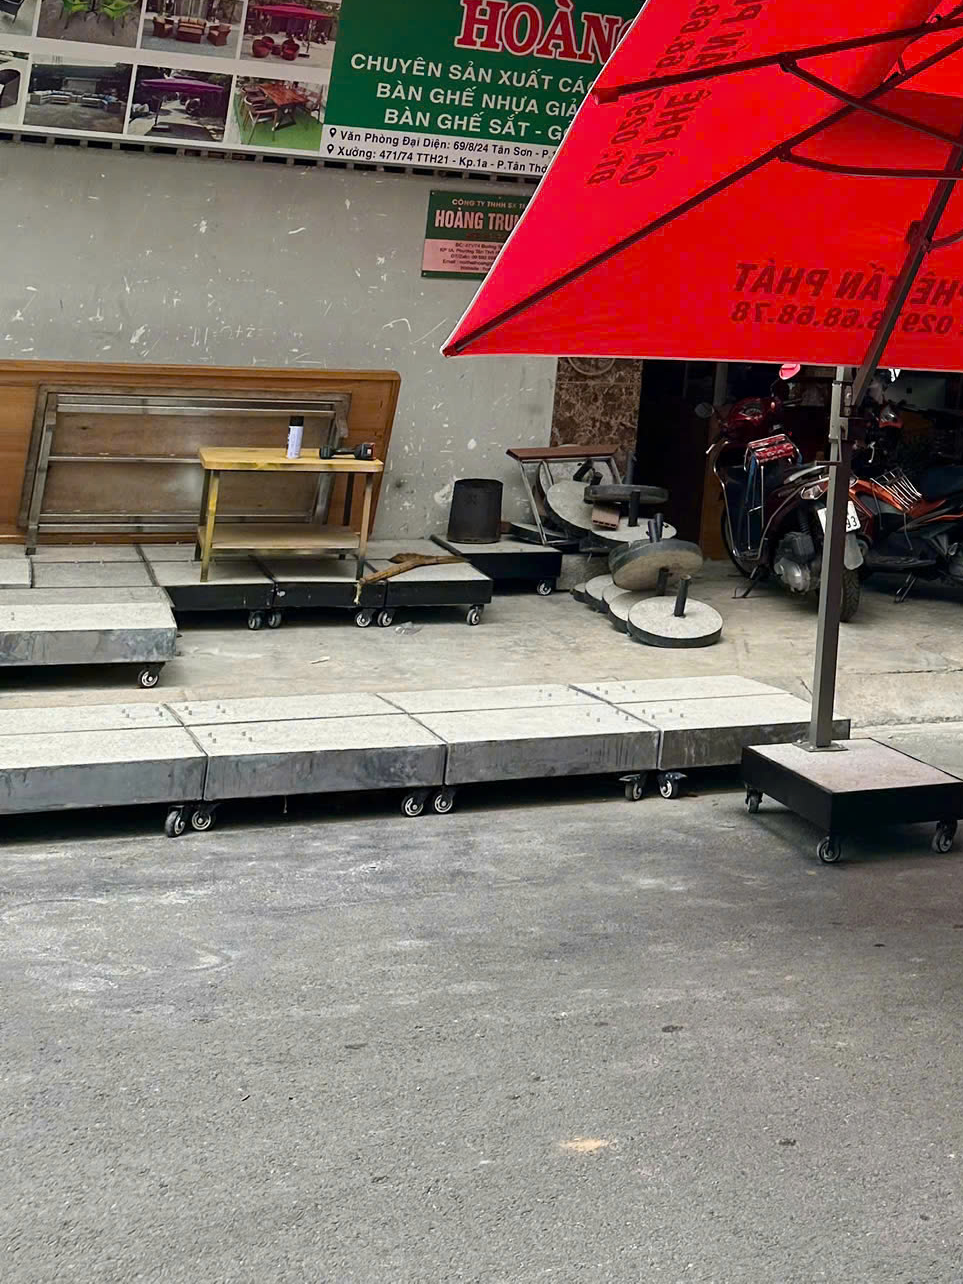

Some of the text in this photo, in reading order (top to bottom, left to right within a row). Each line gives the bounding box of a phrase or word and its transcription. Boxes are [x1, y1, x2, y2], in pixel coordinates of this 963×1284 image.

[350, 53, 442, 78] CHUYÊN
[449, 60, 493, 84] SẢN
[498, 68, 554, 91] XUẤT
[376, 82, 423, 103] BÀN
[429, 84, 477, 107] GHẾ
[482, 93, 539, 115] NHỰA
[384, 107, 430, 129] BÀN
[437, 110, 483, 133] GHẾ
[488, 114, 531, 137] SẮT
[548, 119, 572, 141] G
[337, 146, 376, 161] Xưởng:
[379, 150, 413, 162] 471/74
[416, 154, 449, 165] TTH21
[458, 157, 487, 170] Kp.1a
[340, 130, 362, 143] Văn
[364, 132, 400, 147] Phòng
[402, 136, 420, 149] Đại
[423, 138, 450, 151] Diện:
[453, 141, 489, 154] 69/8/24
[492, 144, 511, 156] Tân
[513, 147, 533, 158] Sơn
[452, 198, 476, 208] CÔNG
[434, 207, 484, 230] HOÀNG
